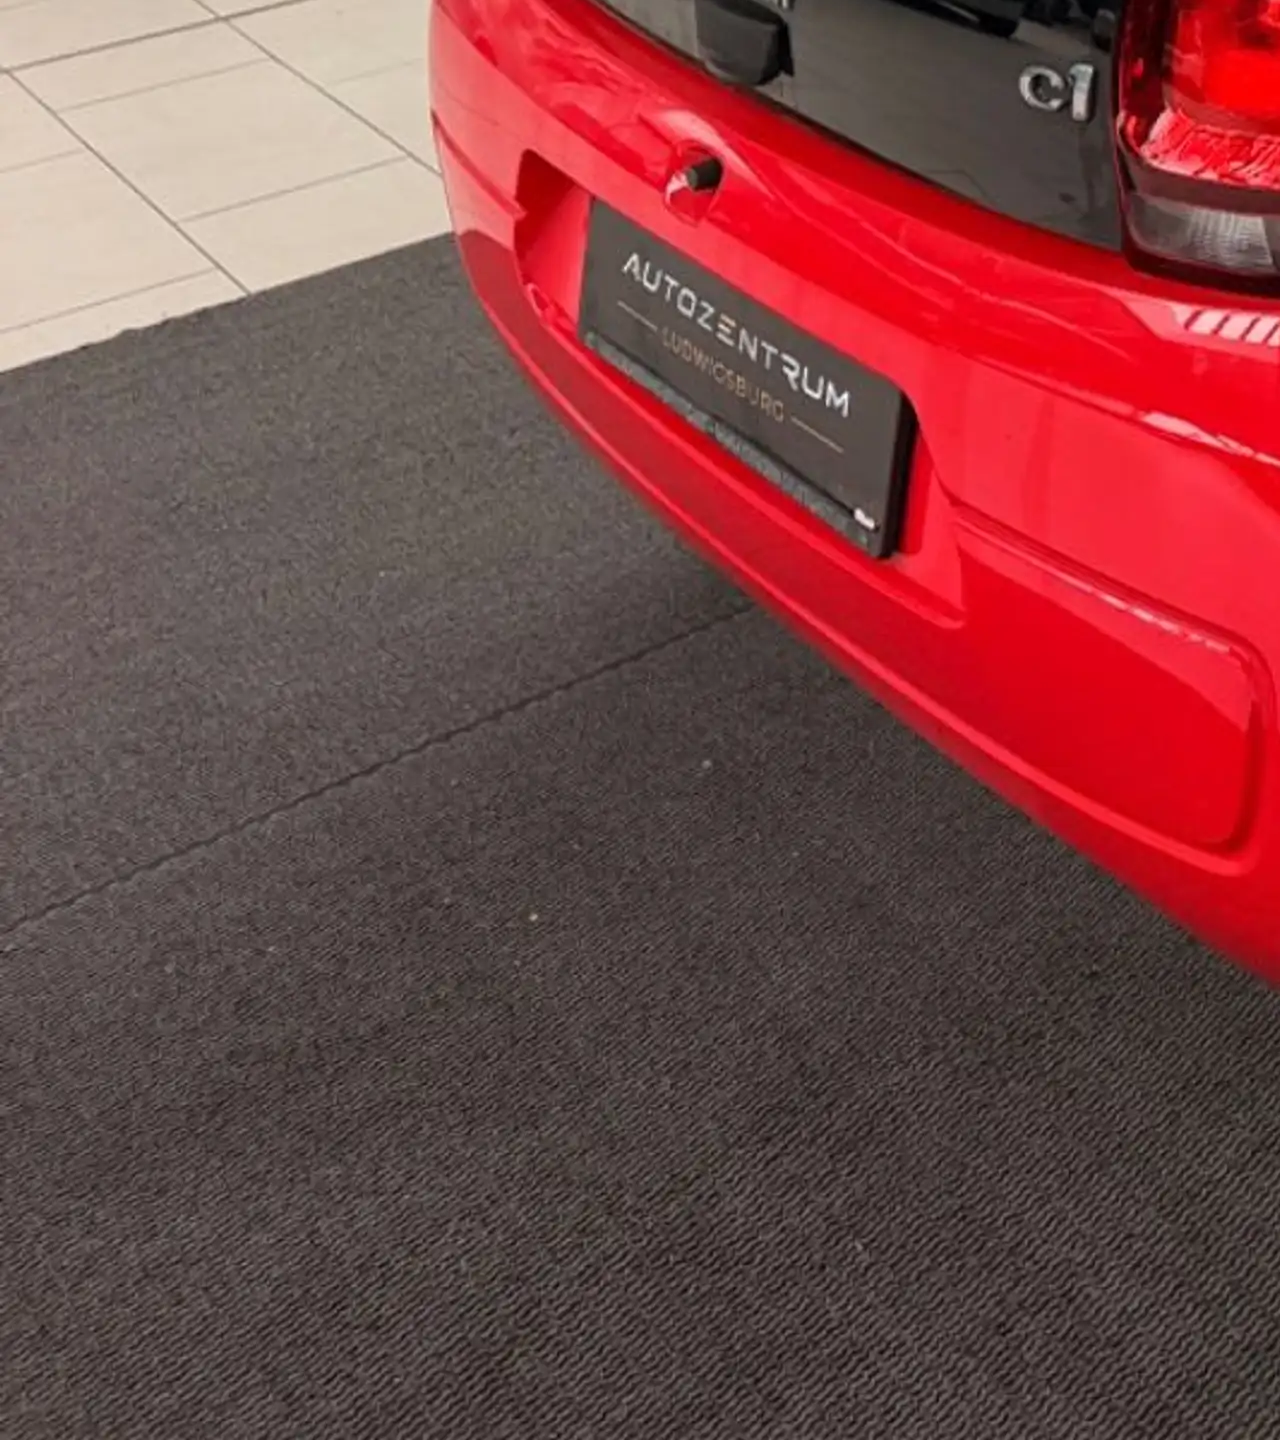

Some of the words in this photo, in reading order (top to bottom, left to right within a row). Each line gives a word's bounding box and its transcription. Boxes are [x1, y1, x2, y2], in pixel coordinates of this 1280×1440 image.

[1019, 62, 1095, 123] C1
[620, 252, 852, 420] AUTOZENTRUM
[661, 326, 785, 424] LUDWIGSBURG
